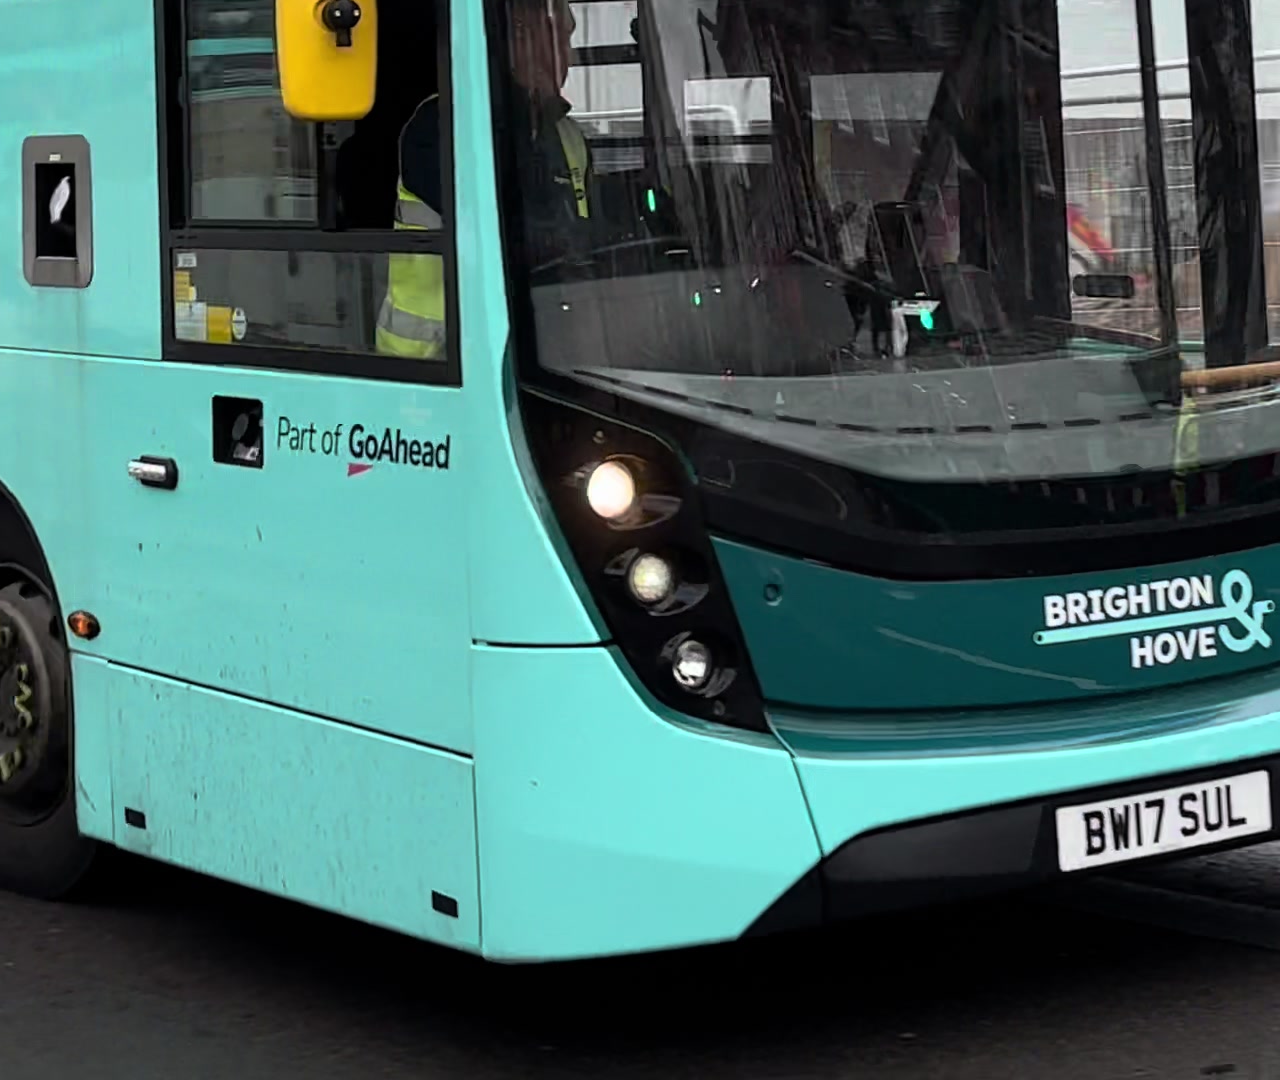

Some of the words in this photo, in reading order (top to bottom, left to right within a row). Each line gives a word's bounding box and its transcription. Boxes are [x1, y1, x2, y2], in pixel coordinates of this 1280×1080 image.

[277, 415, 317, 454] Part
[321, 423, 344, 457] of
[348, 423, 451, 470] GoAhead
[1043, 574, 1215, 627] BRIGHTON
[1220, 569, 1275, 653] &
[1130, 626, 1218, 668] HOVE
[1082, 798, 1166, 857] BW17
[1177, 784, 1248, 838] SUL
